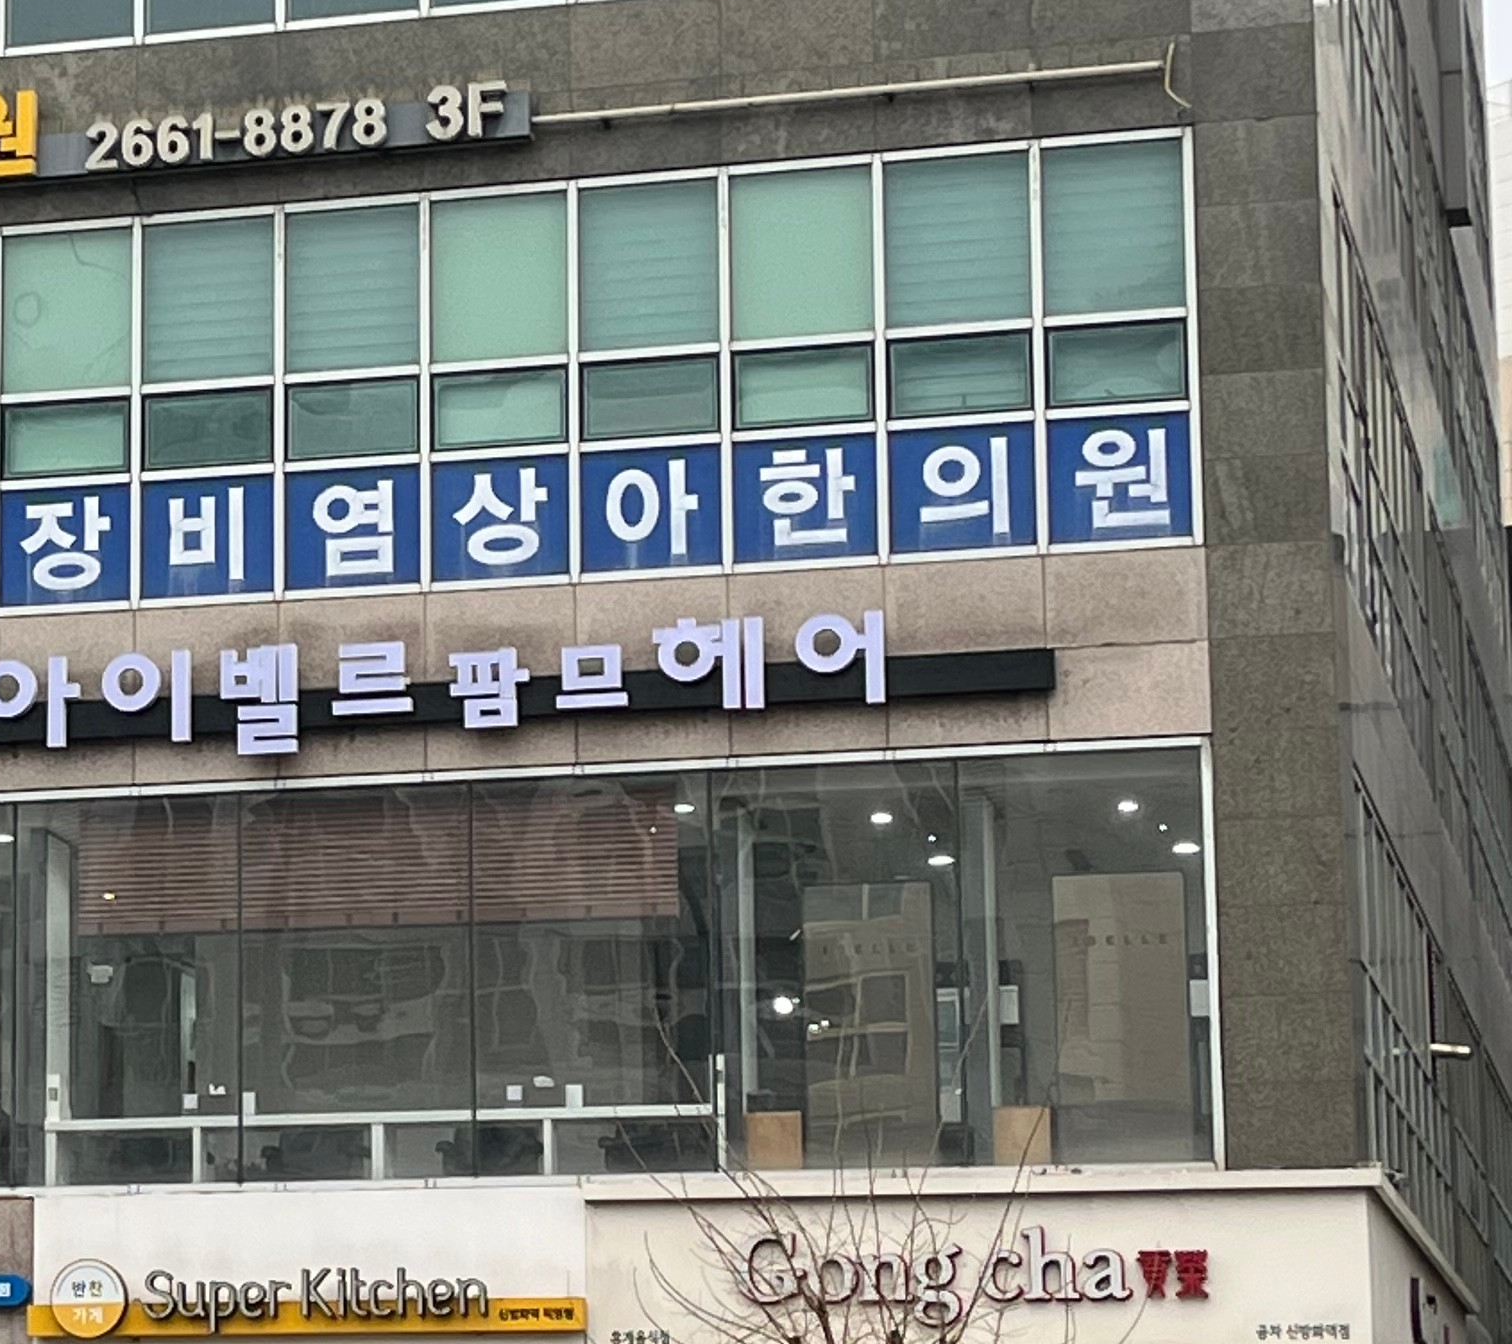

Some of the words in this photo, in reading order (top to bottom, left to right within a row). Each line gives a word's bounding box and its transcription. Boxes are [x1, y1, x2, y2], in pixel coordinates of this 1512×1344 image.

[85, 94, 391, 173] 2661-8878
[424, 79, 510, 143] 3F
[142, 1268, 293, 1334] Super
[298, 1266, 489, 1319] Kitchen
[739, 1231, 963, 1329] Gong
[988, 1224, 1134, 1303] cha
